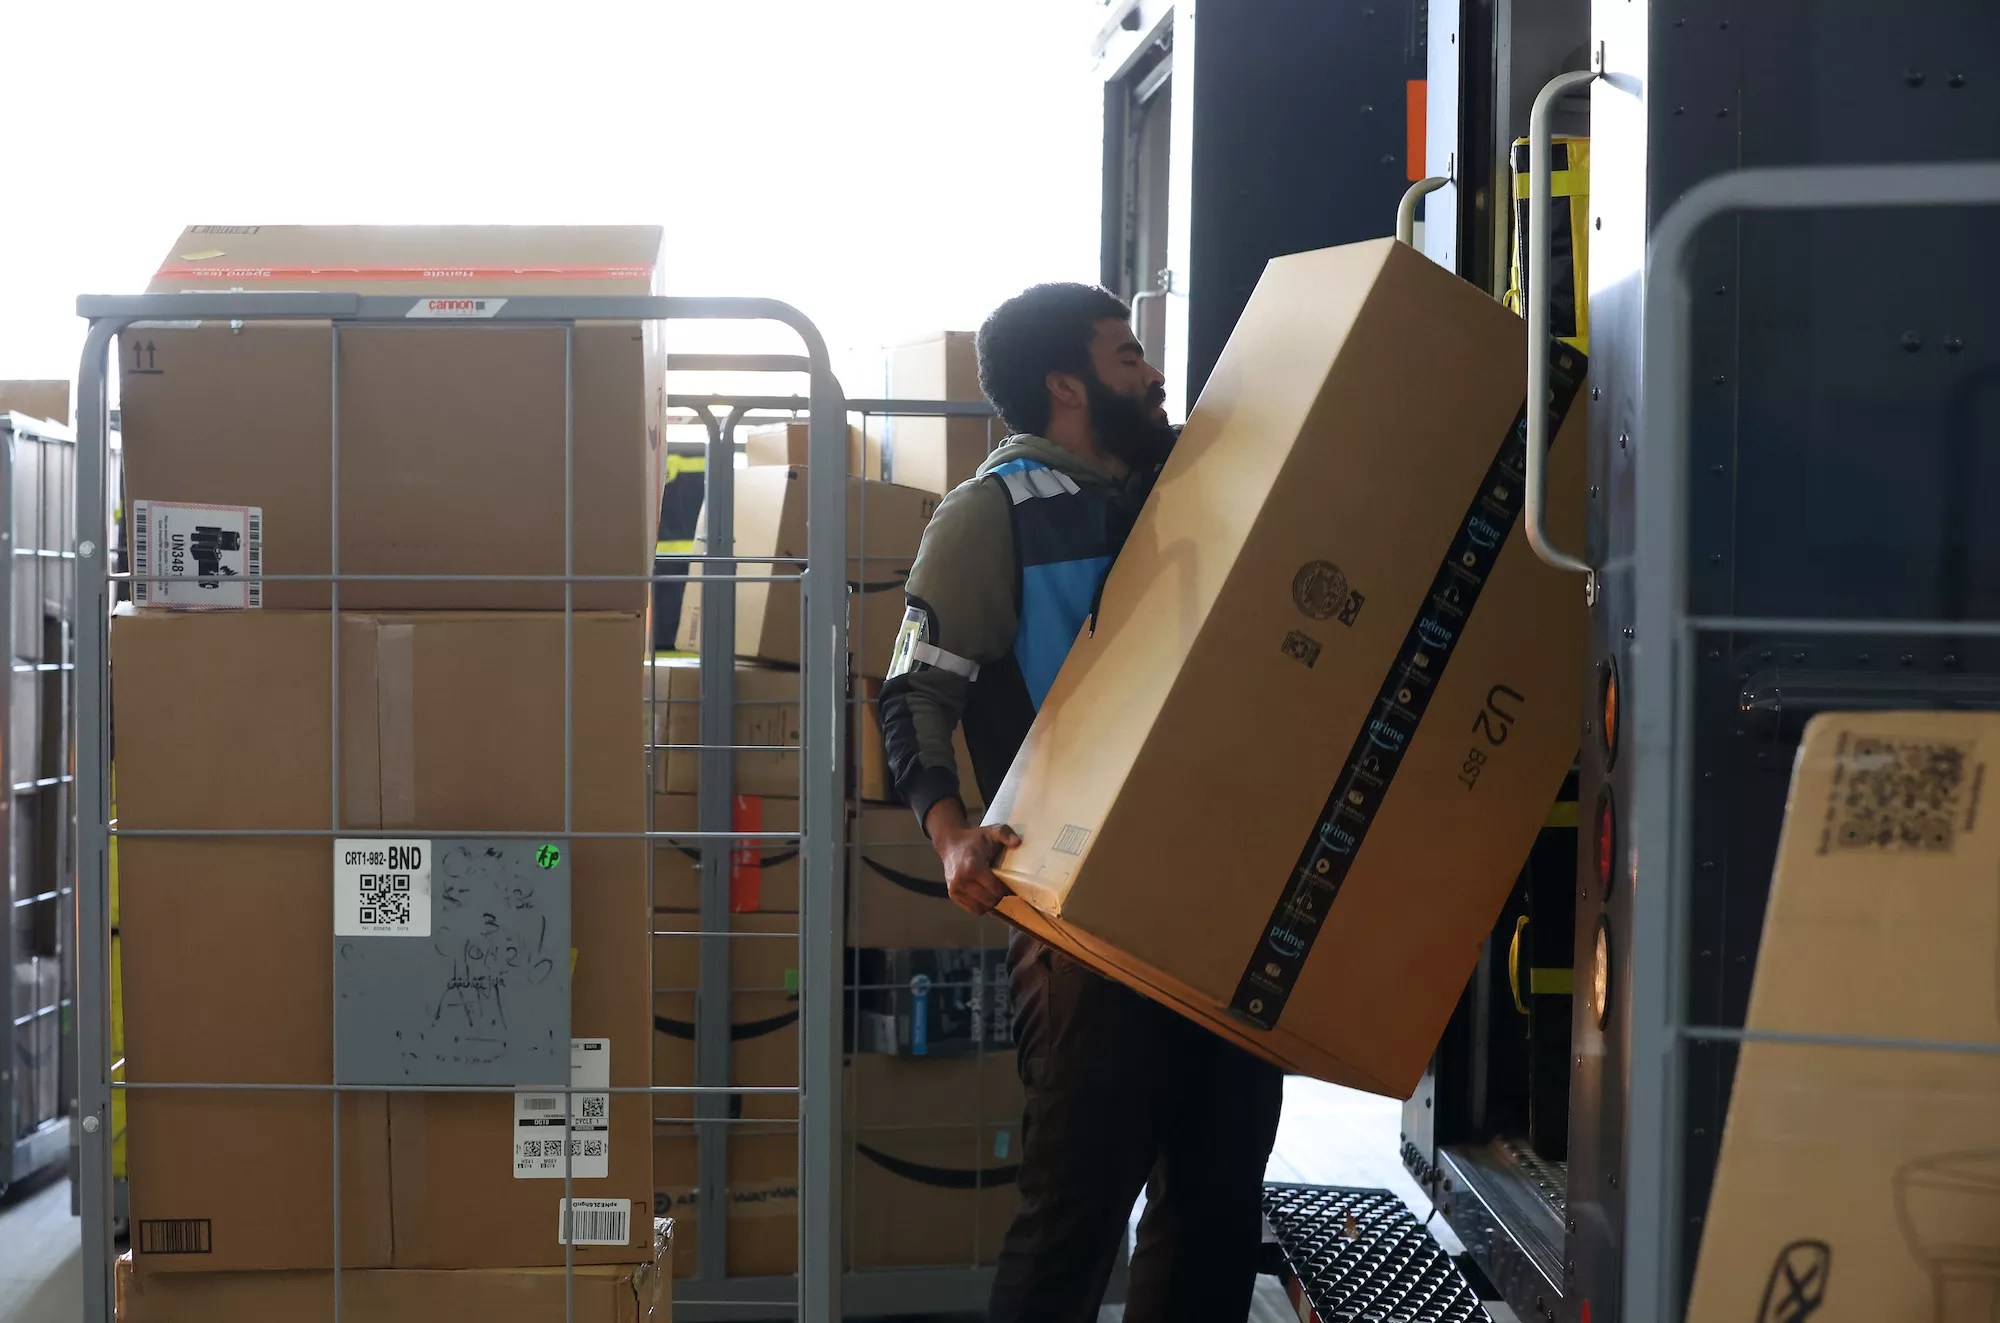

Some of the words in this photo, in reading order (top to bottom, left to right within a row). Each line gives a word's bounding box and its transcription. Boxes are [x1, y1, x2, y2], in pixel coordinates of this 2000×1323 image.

[429, 300, 474, 310] cannon
[1469, 516, 1500, 539] prime
[1419, 617, 1452, 640] prime
[1472, 684, 1525, 747] U2
[1370, 719, 1403, 742] prime
[1458, 748, 1487, 792] BST
[1320, 822, 1355, 845] prime
[345, 846, 421, 870] CRT1-982-BND
[1270, 925, 1304, 949] prime
